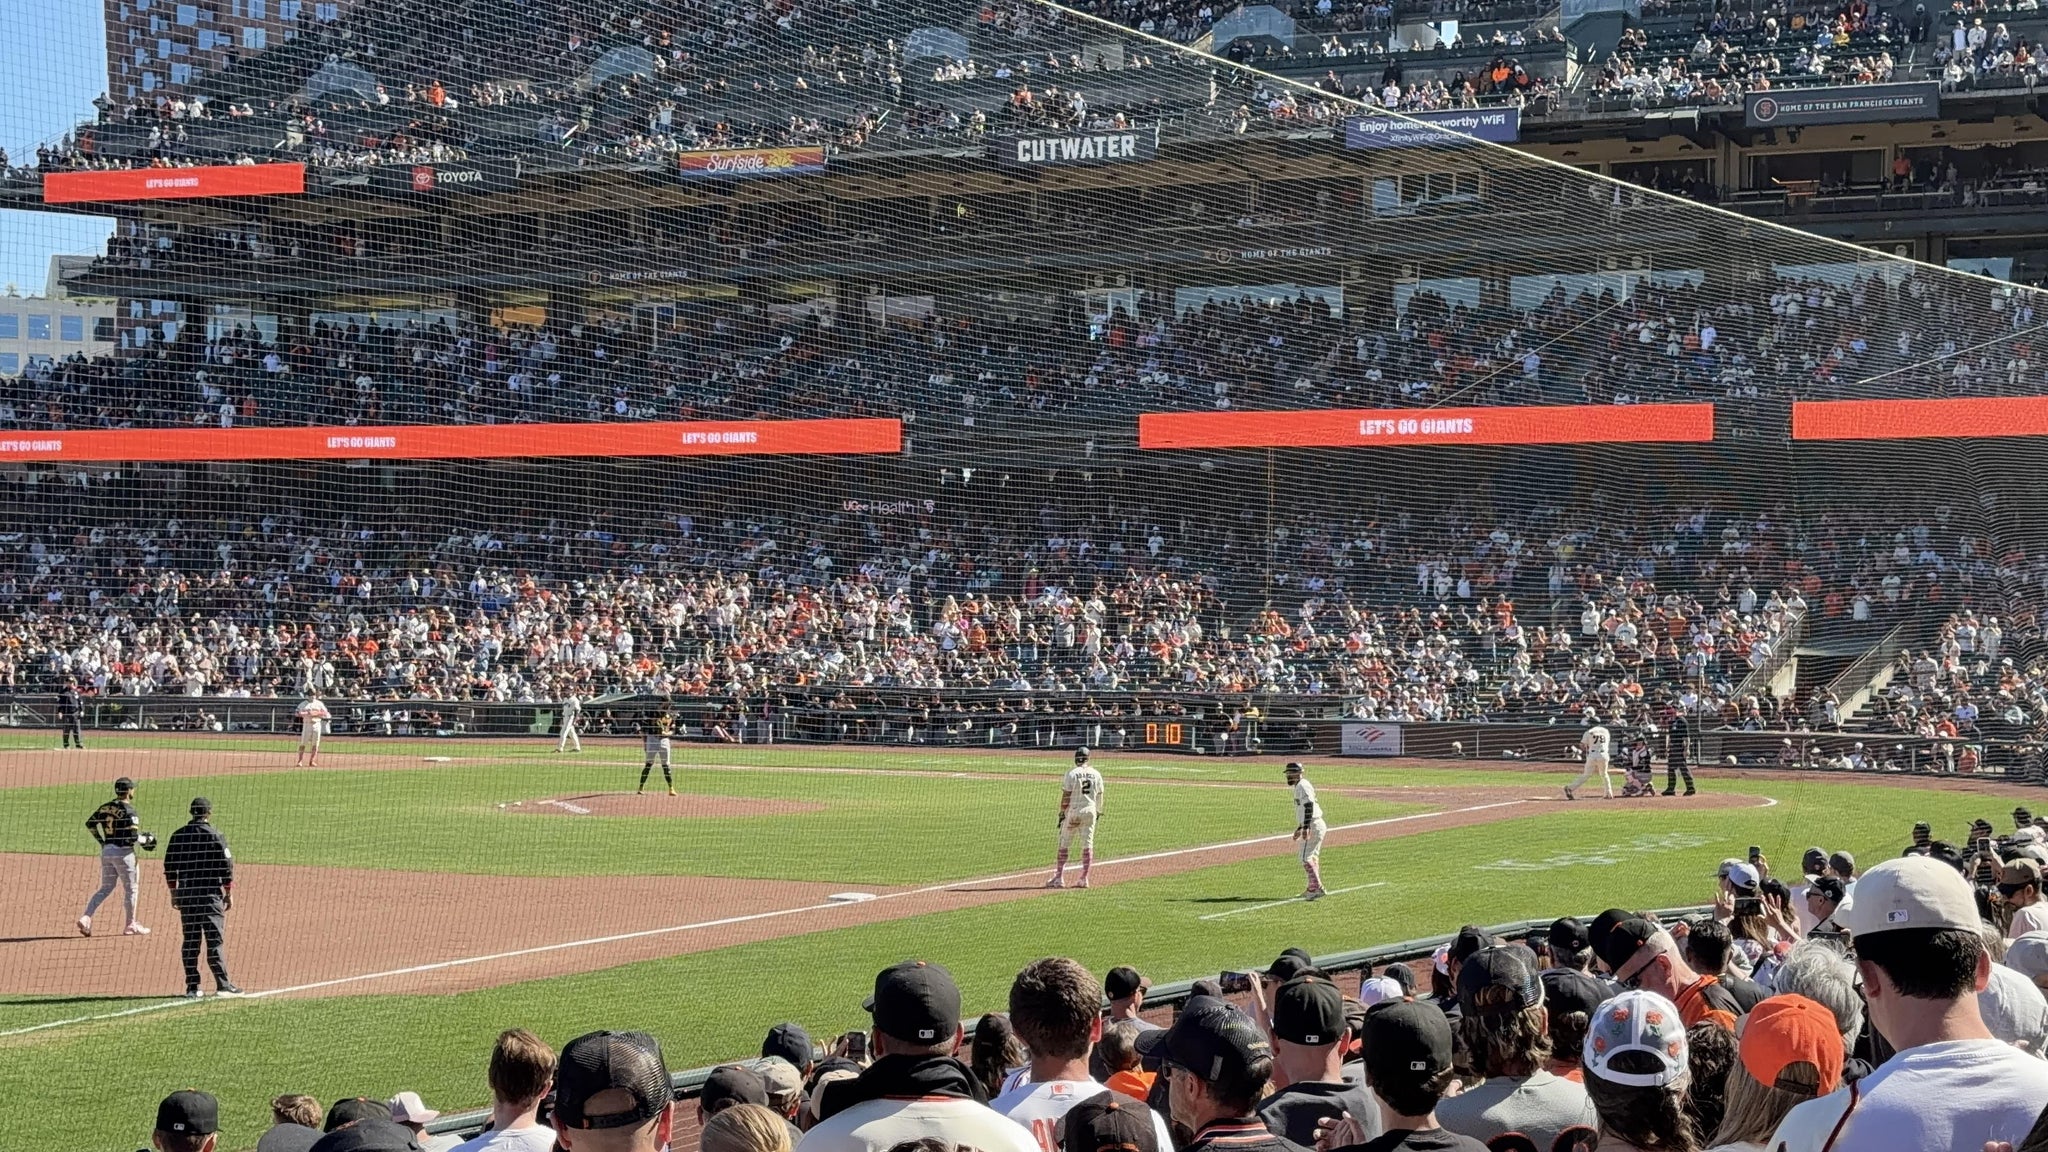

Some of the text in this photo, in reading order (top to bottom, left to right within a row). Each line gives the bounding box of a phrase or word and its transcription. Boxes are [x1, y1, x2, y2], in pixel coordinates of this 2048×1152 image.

[1780, 97, 1924, 112] HOME OF THE SAN FRANCISCO GIANTS
[1359, 121, 1388, 133] Enjoy
[1481, 113, 1505, 125] WiFi
[1018, 135, 1135, 162] CUTWATER
[707, 153, 764, 172] Surfside
[146, 177, 199, 189] LET'S GO GIANTS
[436, 171, 483, 183] TOYOTA
[1241, 250, 1265, 259] HOME
[1281, 248, 1297, 257] THE
[1300, 247, 1331, 256] GIANTS
[1360, 418, 1473, 435] LET'S GO GIANTS
[327, 437, 396, 448] LET'S GO GIANTS
[682, 432, 757, 444] LET'S GO GIANTS
[19, 441, 31, 451] GO
[32, 440, 62, 451] GIANTS
[870, 500, 915, 515] Health
[1081, 780, 1091, 794] 2
